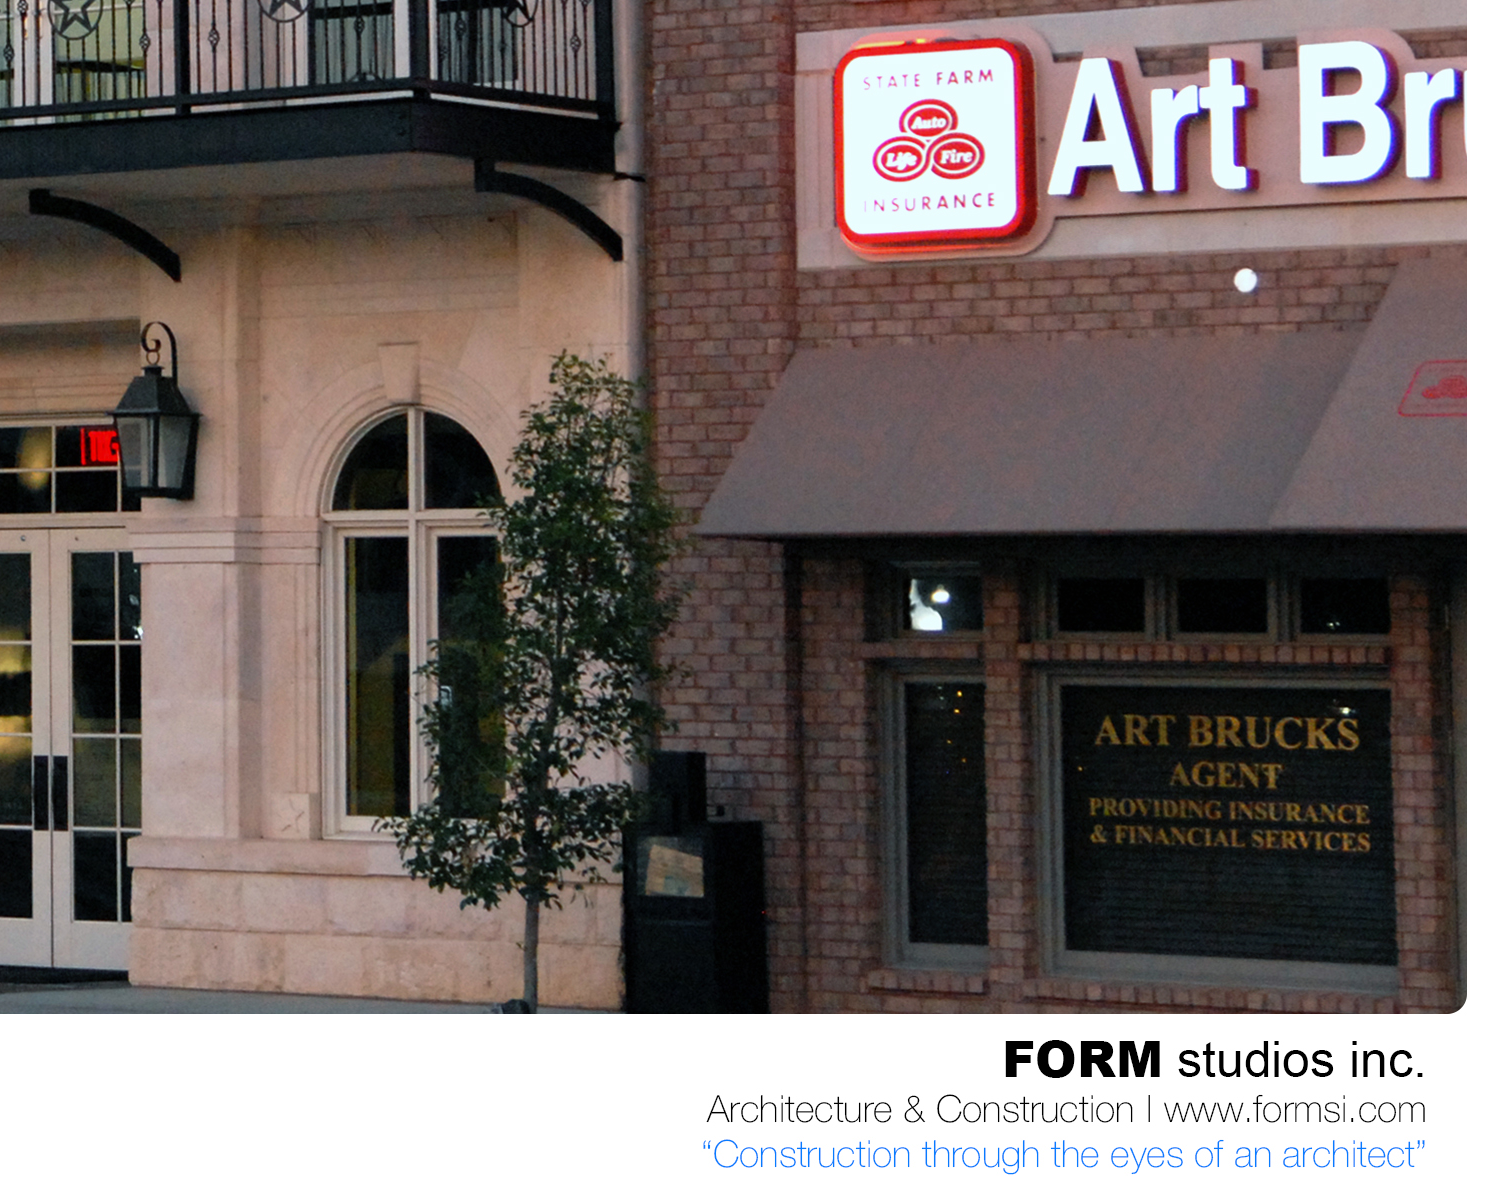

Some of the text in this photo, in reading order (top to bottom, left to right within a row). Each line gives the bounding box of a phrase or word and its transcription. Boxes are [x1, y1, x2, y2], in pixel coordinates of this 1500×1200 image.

[863, 69, 994, 91] STATE FARM
[910, 115, 947, 130] Auto
[1047, 40, 1467, 197] Art Br
[885, 151, 918, 171] Life
[939, 149, 974, 164] Fire
[863, 192, 995, 212] INSURANCE
[1094, 713, 1361, 751] ART BRUCKS
[1170, 761, 1283, 789] AGENT
[1089, 798, 1371, 825] PROVIDING INSURANCE
[1089, 824, 1372, 852] & FINANCIAL SERVICES
